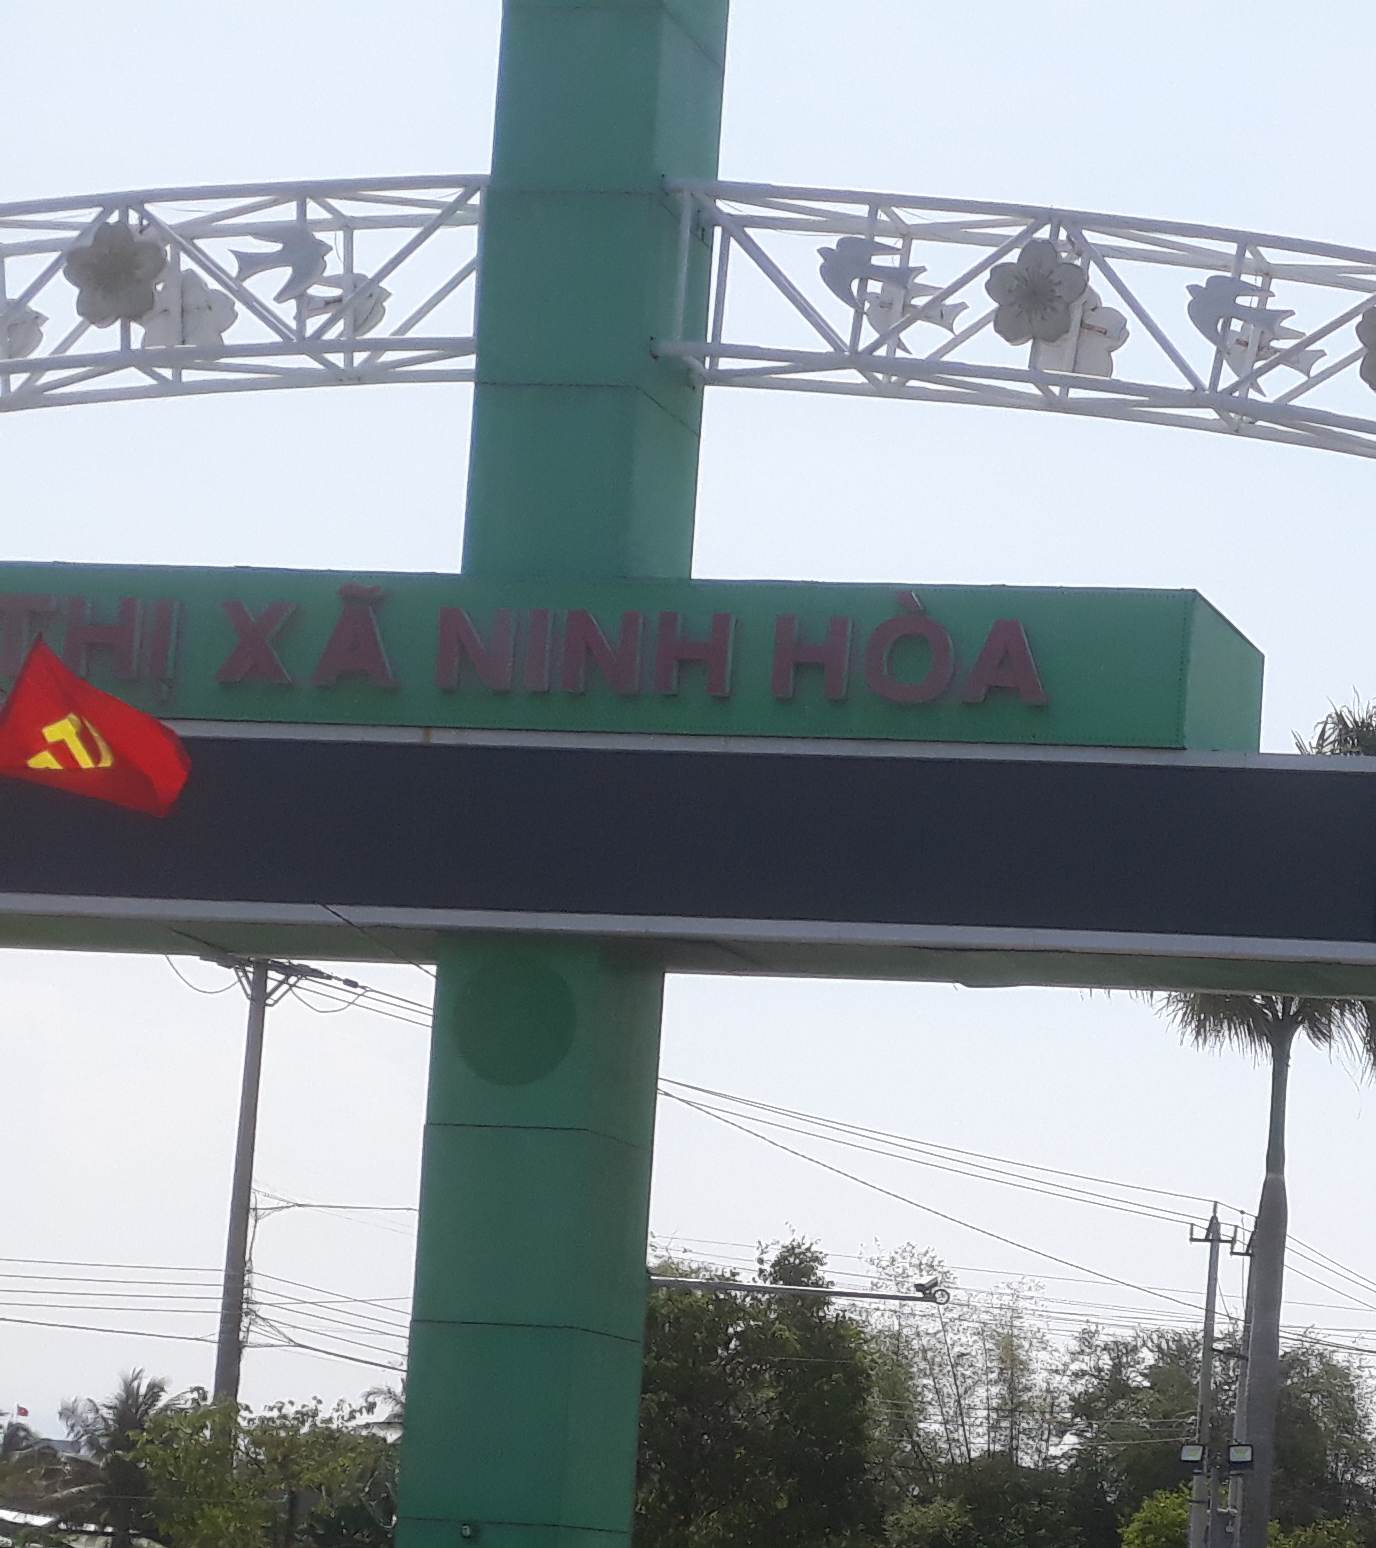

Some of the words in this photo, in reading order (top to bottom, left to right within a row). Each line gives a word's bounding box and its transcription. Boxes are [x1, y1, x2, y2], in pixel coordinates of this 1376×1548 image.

[215, 582, 395, 688] XÃ
[434, 606, 736, 698] NINH
[771, 591, 1049, 706] HÒA
